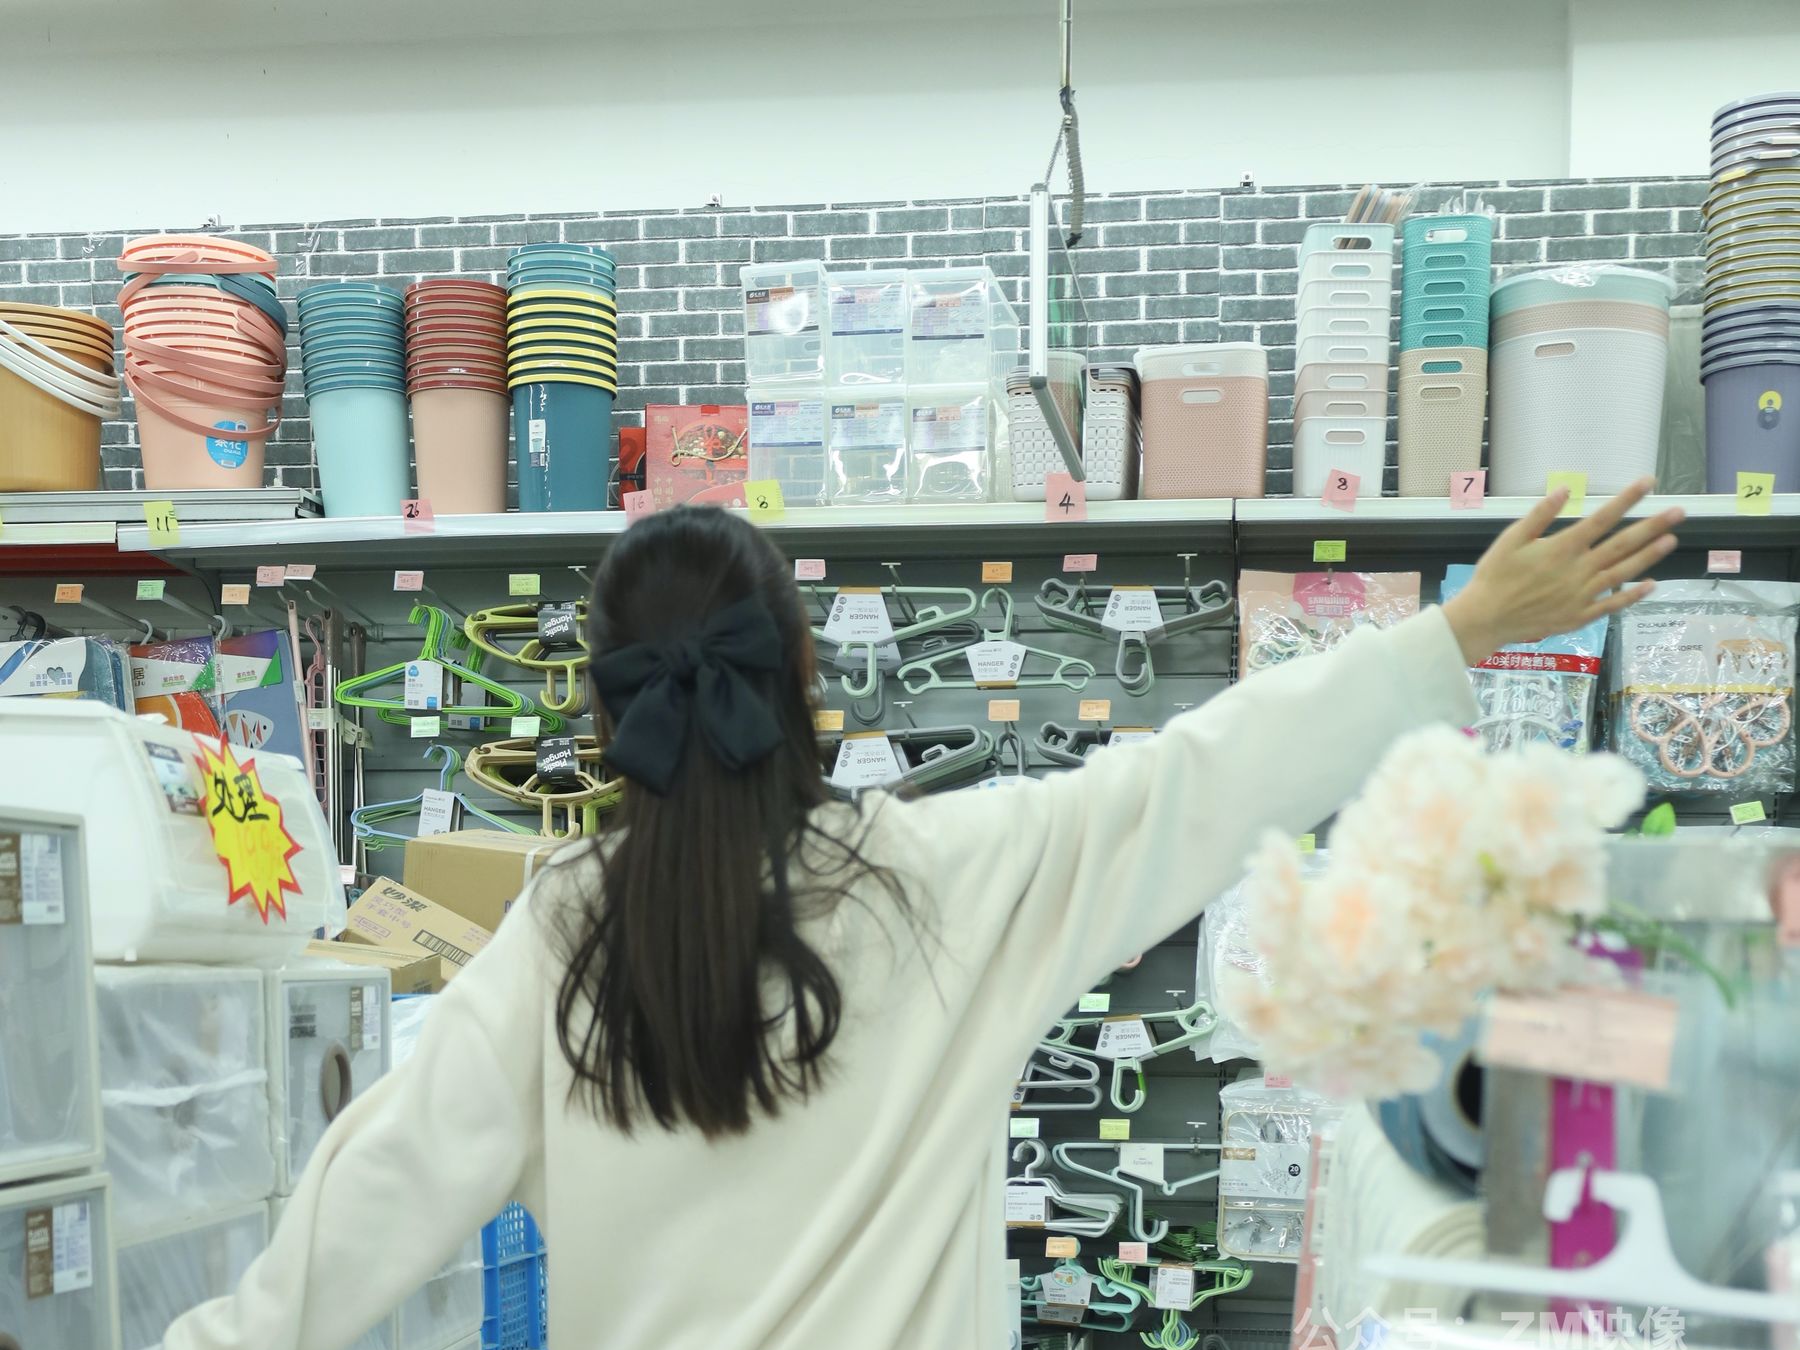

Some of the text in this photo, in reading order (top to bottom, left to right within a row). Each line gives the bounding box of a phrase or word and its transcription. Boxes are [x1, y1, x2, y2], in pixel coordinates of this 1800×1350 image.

[1463, 477, 1475, 494] 7
[405, 501, 420, 518] 26
[632, 494, 645, 511] 16
[756, 495, 769, 509] 8
[1058, 491, 1076, 515] 4
[544, 613, 573, 629] Hanger
[544, 622, 569, 638] Plastic
[542, 748, 572, 765] Hanger
[857, 756, 887, 765] HANGER
[543, 758, 568, 773] Plastic
